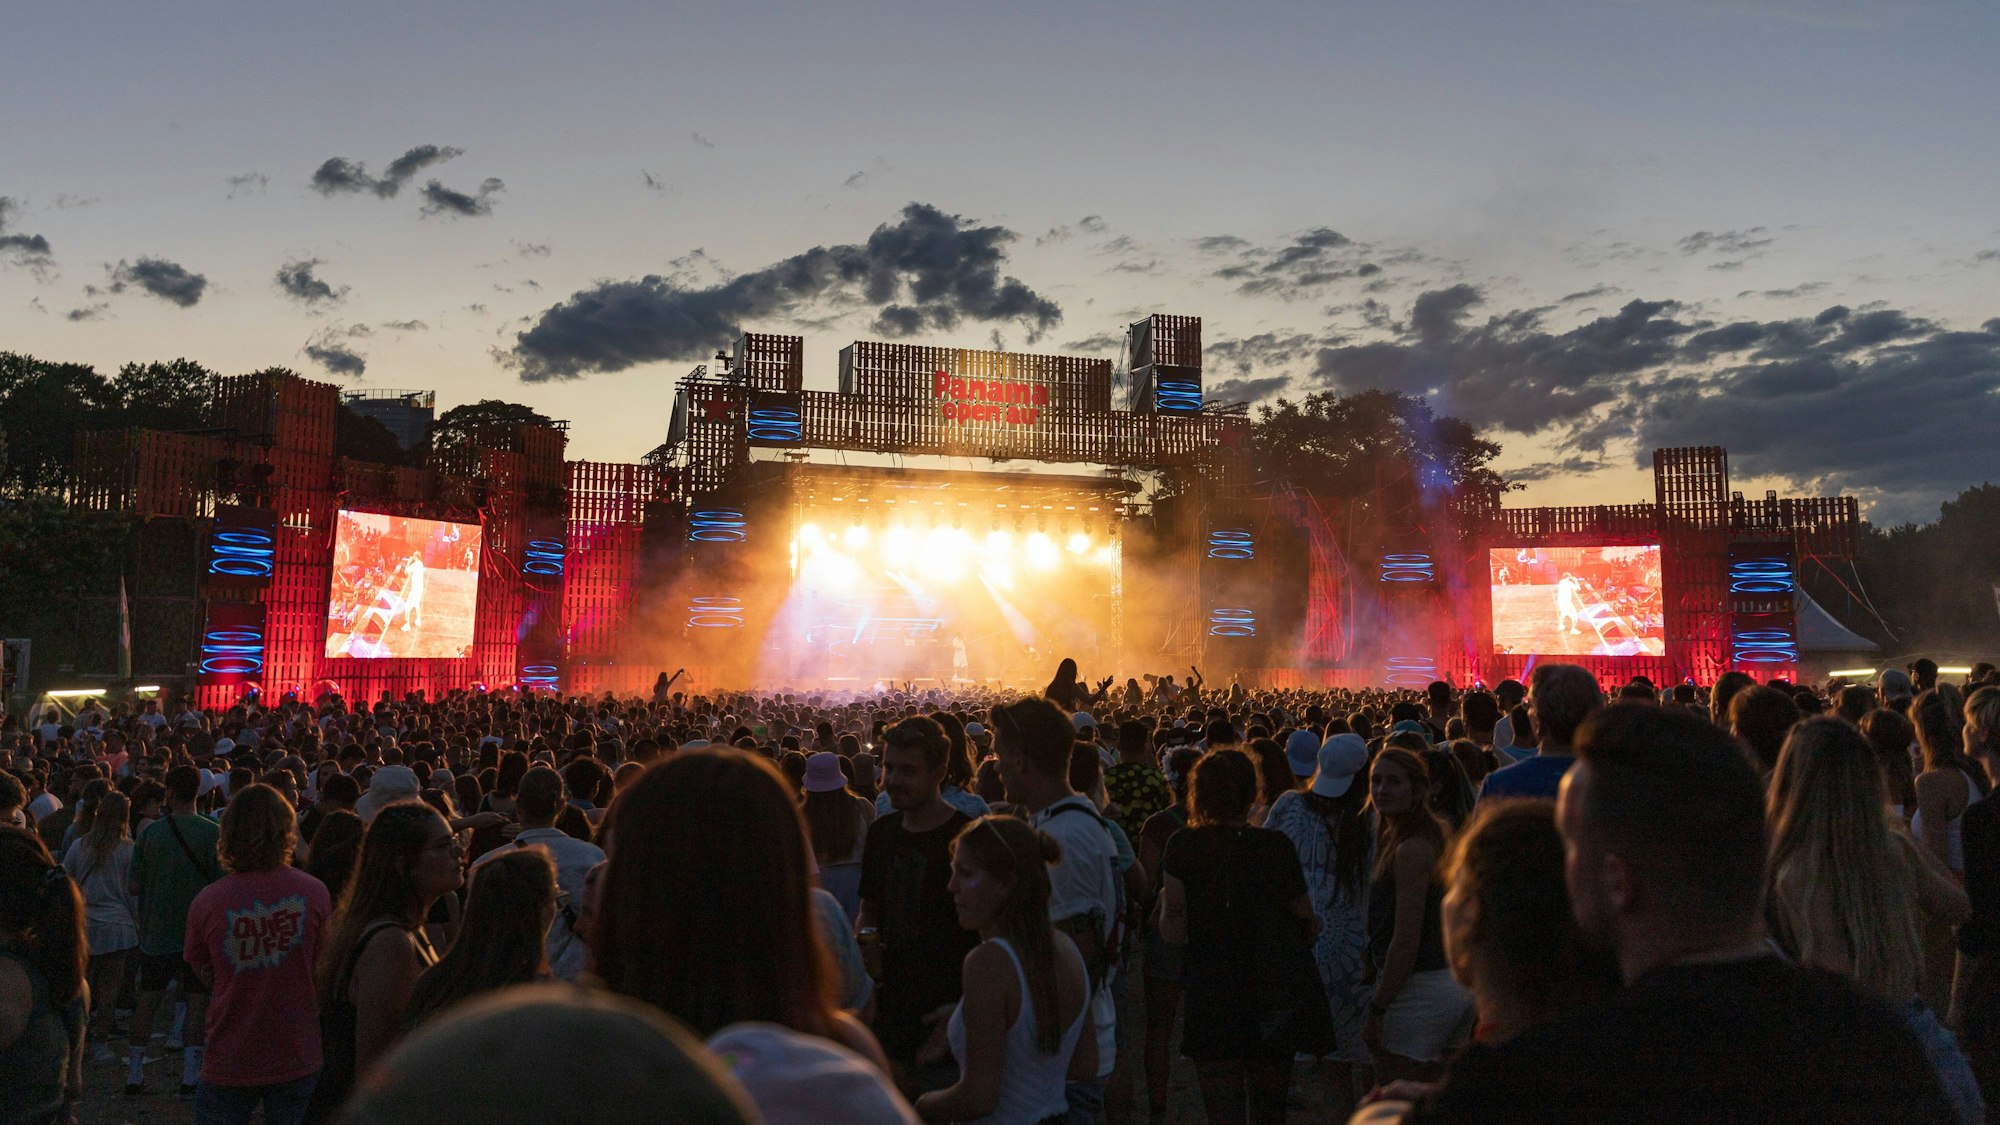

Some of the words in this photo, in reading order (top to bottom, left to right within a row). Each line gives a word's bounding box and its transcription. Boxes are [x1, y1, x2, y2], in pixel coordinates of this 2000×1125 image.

[935, 370, 1048, 405] Panama
[943, 401, 1001, 424] open
[1005, 406, 1039, 424] air
[234, 909, 301, 938] QUIET
[240, 931, 289, 960] LIFE
